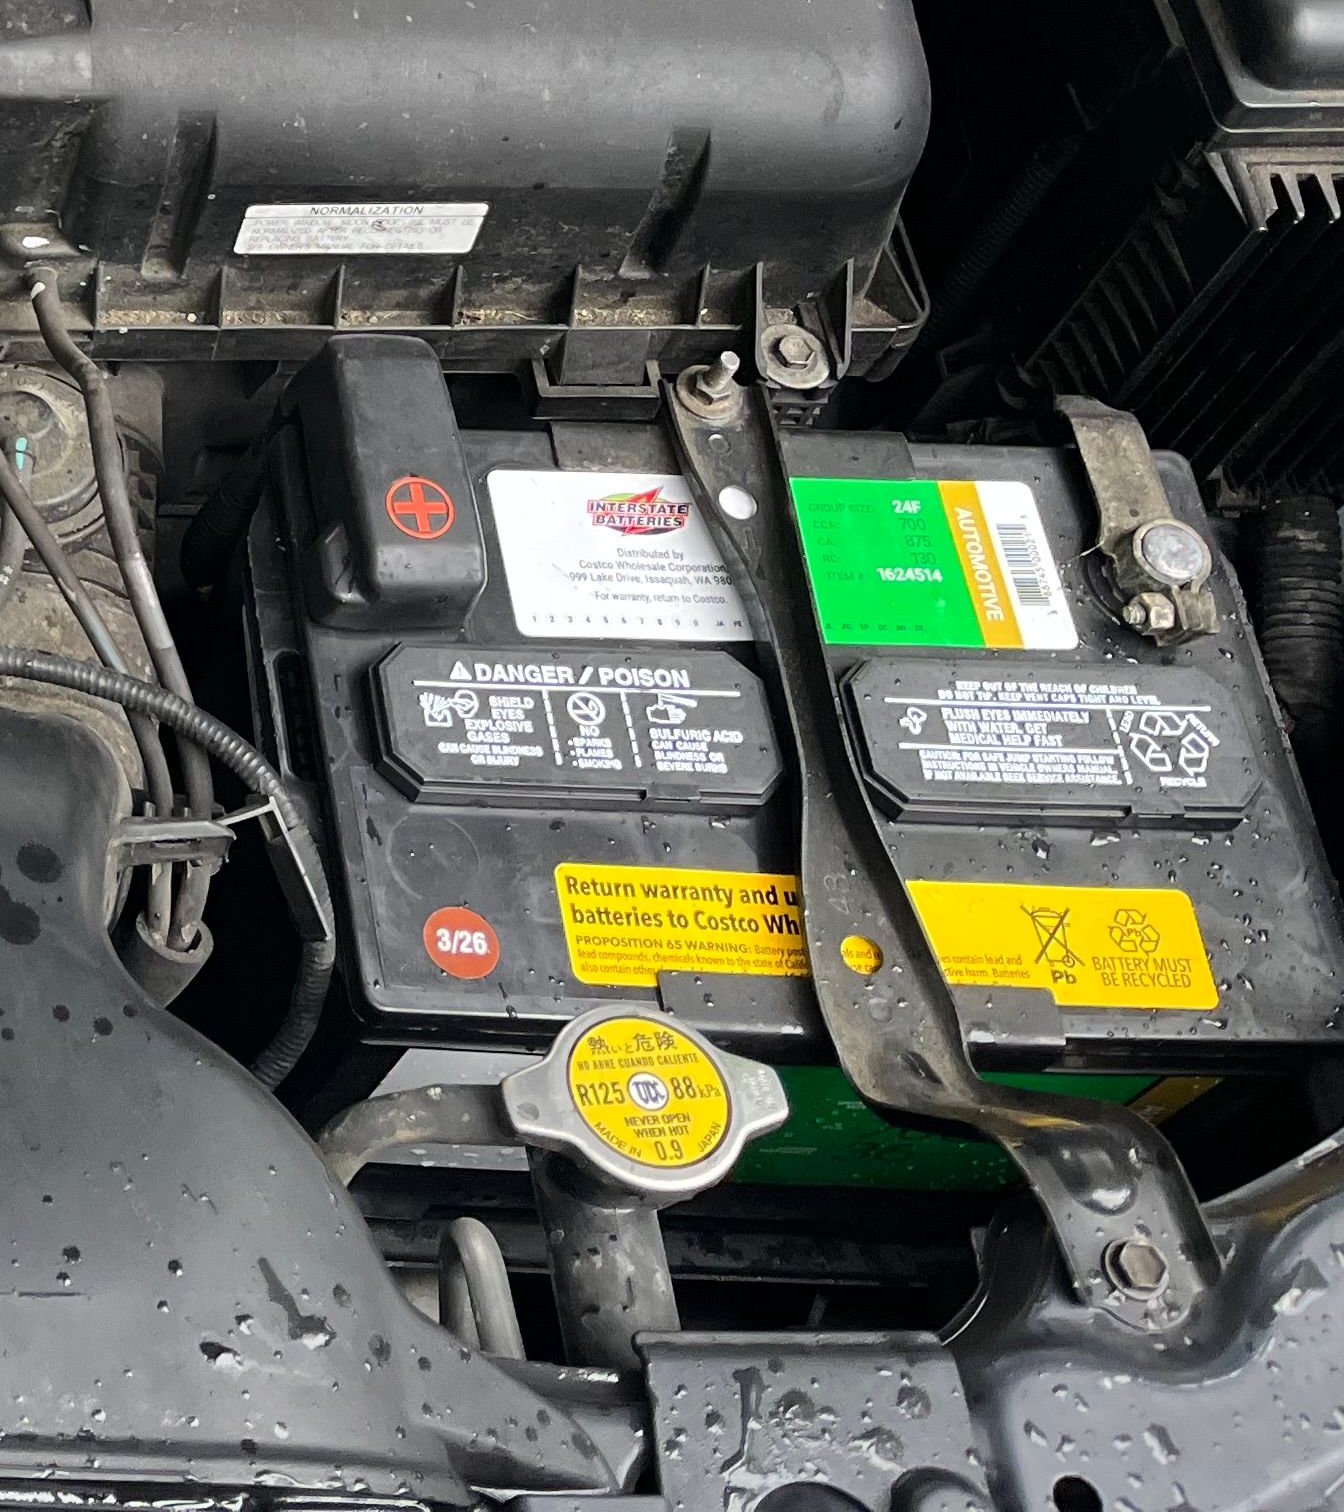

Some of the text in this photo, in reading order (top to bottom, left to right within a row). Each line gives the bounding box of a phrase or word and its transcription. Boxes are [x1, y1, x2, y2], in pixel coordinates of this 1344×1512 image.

[310, 206, 425, 216] NORMALIZATION
[588, 500, 689, 516] INTERSTATE
[808, 502, 846, 514] GROUP
[892, 500, 921, 515] 24F
[594, 513, 684, 528] BATTERIES
[898, 517, 927, 531] 700
[905, 535, 932, 548] 875
[616, 547, 684, 562] Distributed by
[911, 553, 937, 566] 130
[578, 559, 614, 570] Costco
[614, 560, 666, 573] Wholesale
[954, 506, 1005, 622] AUTOMOTIVE
[569, 570, 733, 588] 999 Lake Drive, Issaquah, WA 980
[827, 567, 944, 583] ITEM 1624514
[594, 591, 611, 601] For
[612, 593, 652, 605] warranty,
[653, 593, 680, 604] return
[681, 594, 692, 604] to
[473, 662, 575, 685] DANGER
[598, 667, 691, 689] POISON
[488, 695, 536, 709] SHIELD
[491, 707, 525, 720] EYES
[940, 707, 1090, 724] FLUSH EYES IMMEDIATELY
[464, 718, 534, 734] EXPLOSIVE
[579, 724, 601, 737] NO
[944, 719, 978, 733] WITH
[1024, 722, 1048, 735] GET
[466, 730, 511, 744] GASES
[648, 727, 744, 743] SULFURIC ACID
[948, 731, 1063, 747] MEDICAL HELP FAST
[651, 740, 710, 752] CAN CAUSE
[654, 750, 726, 763] BLINDNESS OR
[656, 760, 729, 774] SEVERE BURNS
[566, 875, 798, 906] Return warranty and u
[570, 903, 800, 936] batteries to Costco Wh
[436, 927, 486, 954] 3/26
[1126, 928, 1142, 938] Pb
[575, 934, 663, 950] PROPOSITION
[666, 938, 683, 950] 65
[754, 944, 785, 957] Battery
[577, 948, 594, 959] lead
[652, 952, 695, 964] chemicals
[696, 954, 724, 965] known
[725, 956, 736, 966] to
[736, 956, 752, 967] the
[752, 957, 774, 968] state
[855, 949, 873, 960] and
[952, 954, 1023, 966] contain lead and
[580, 962, 600, 973] also
[599, 964, 632, 975] contain
[1092, 955, 1193, 973] BATTERY MUST
[992, 970, 1031, 979] Batteries
[1051, 969, 1077, 985] Pb
[1102, 971, 1192, 989] BE RECYCLED
[587, 1031, 678, 1055] 熱いと危険
[576, 1052, 700, 1071] NO ABRE CUANDO CALIENTE
[576, 1081, 625, 1107] R125
[623, 1112, 691, 1127] NEVER OPEN
[594, 1121, 722, 1158] MADE IN JAPAN
[633, 1125, 690, 1139] WHEN HOT
[653, 1140, 684, 1162] 0.9
